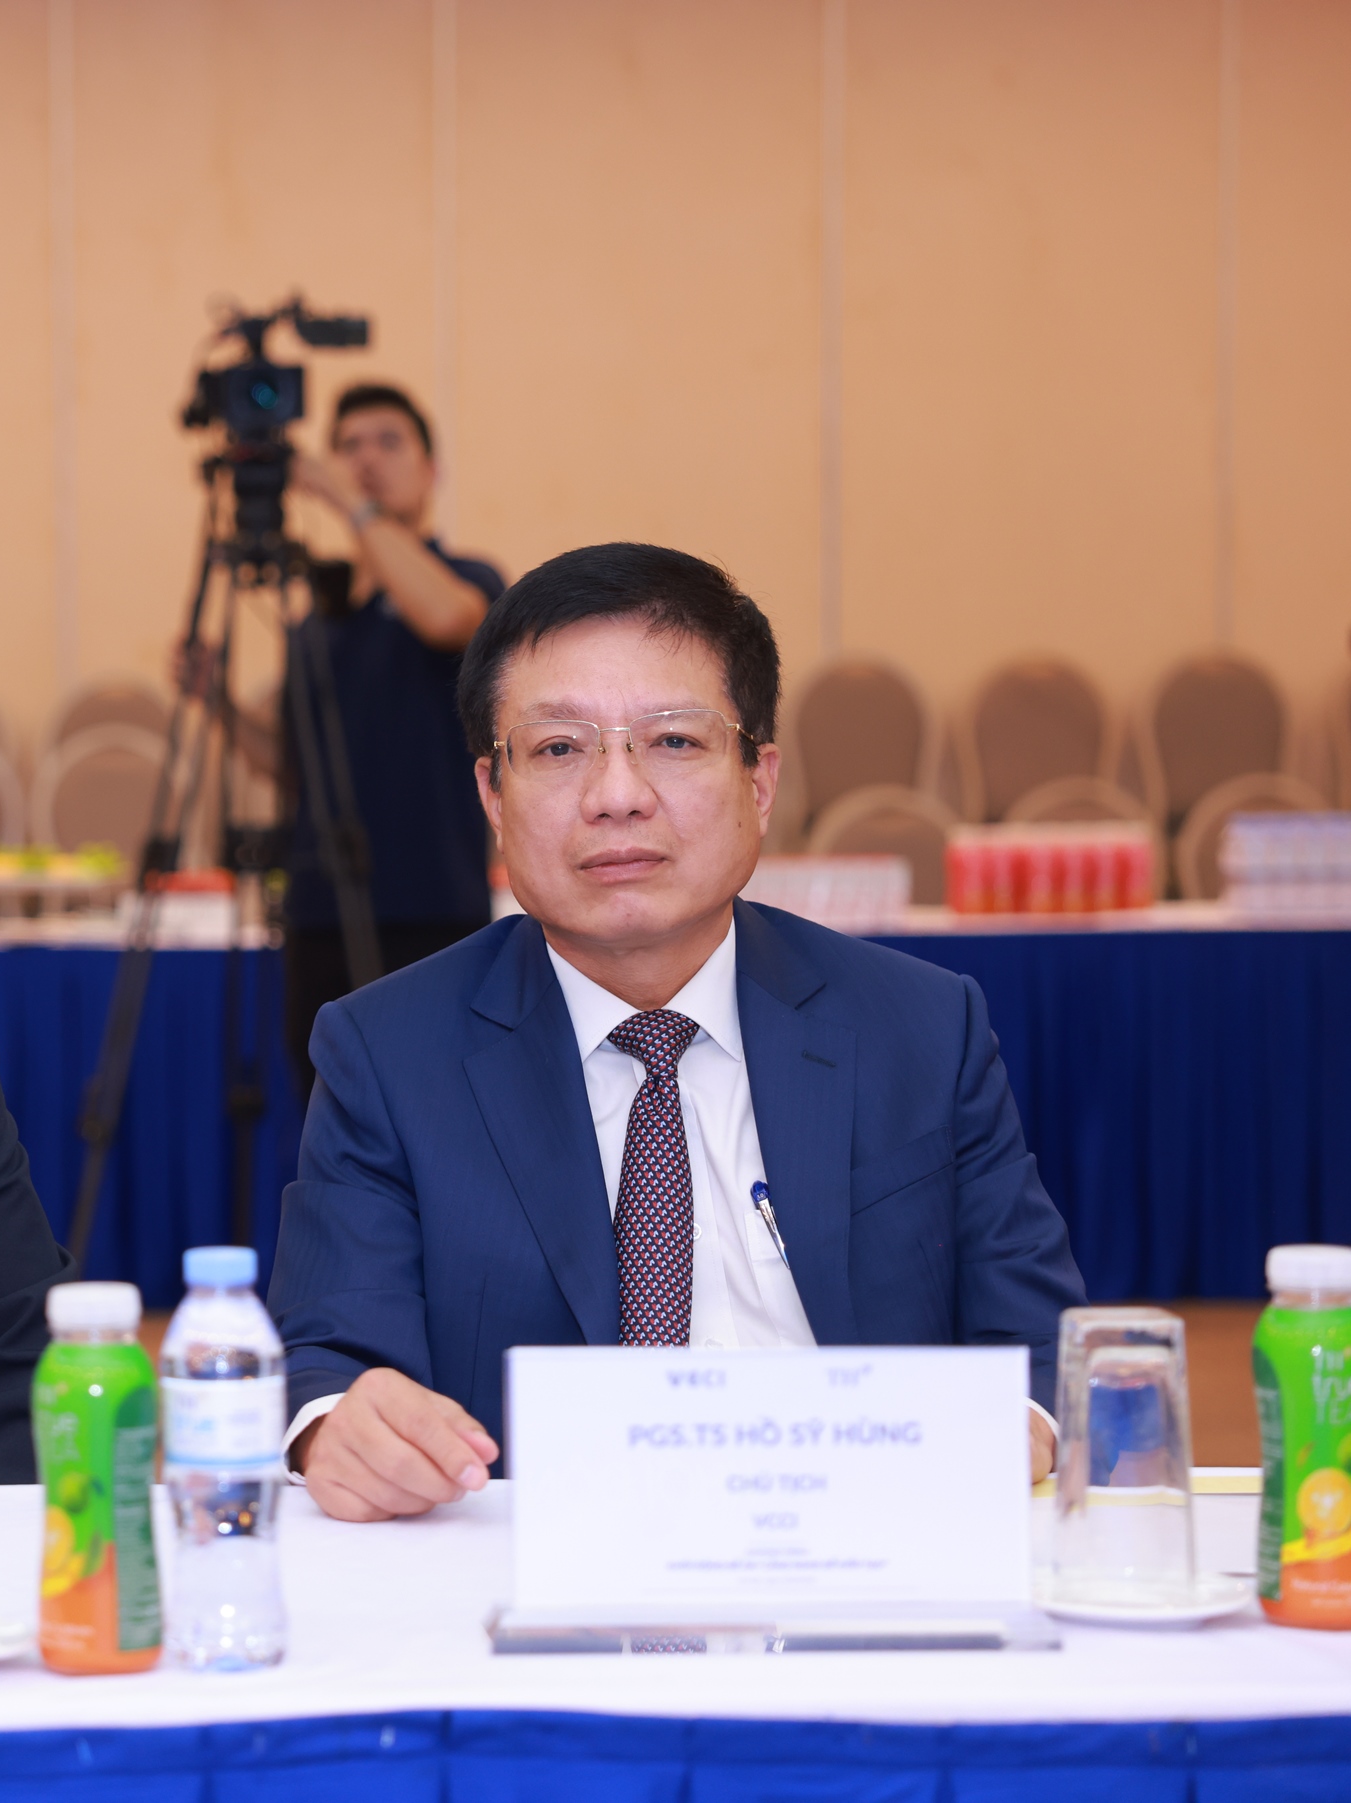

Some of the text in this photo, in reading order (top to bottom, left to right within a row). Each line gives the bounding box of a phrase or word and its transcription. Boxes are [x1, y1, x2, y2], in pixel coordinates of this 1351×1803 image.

[626, 1416, 924, 1449] PGS.TS HỒ SỸ HÙNG
